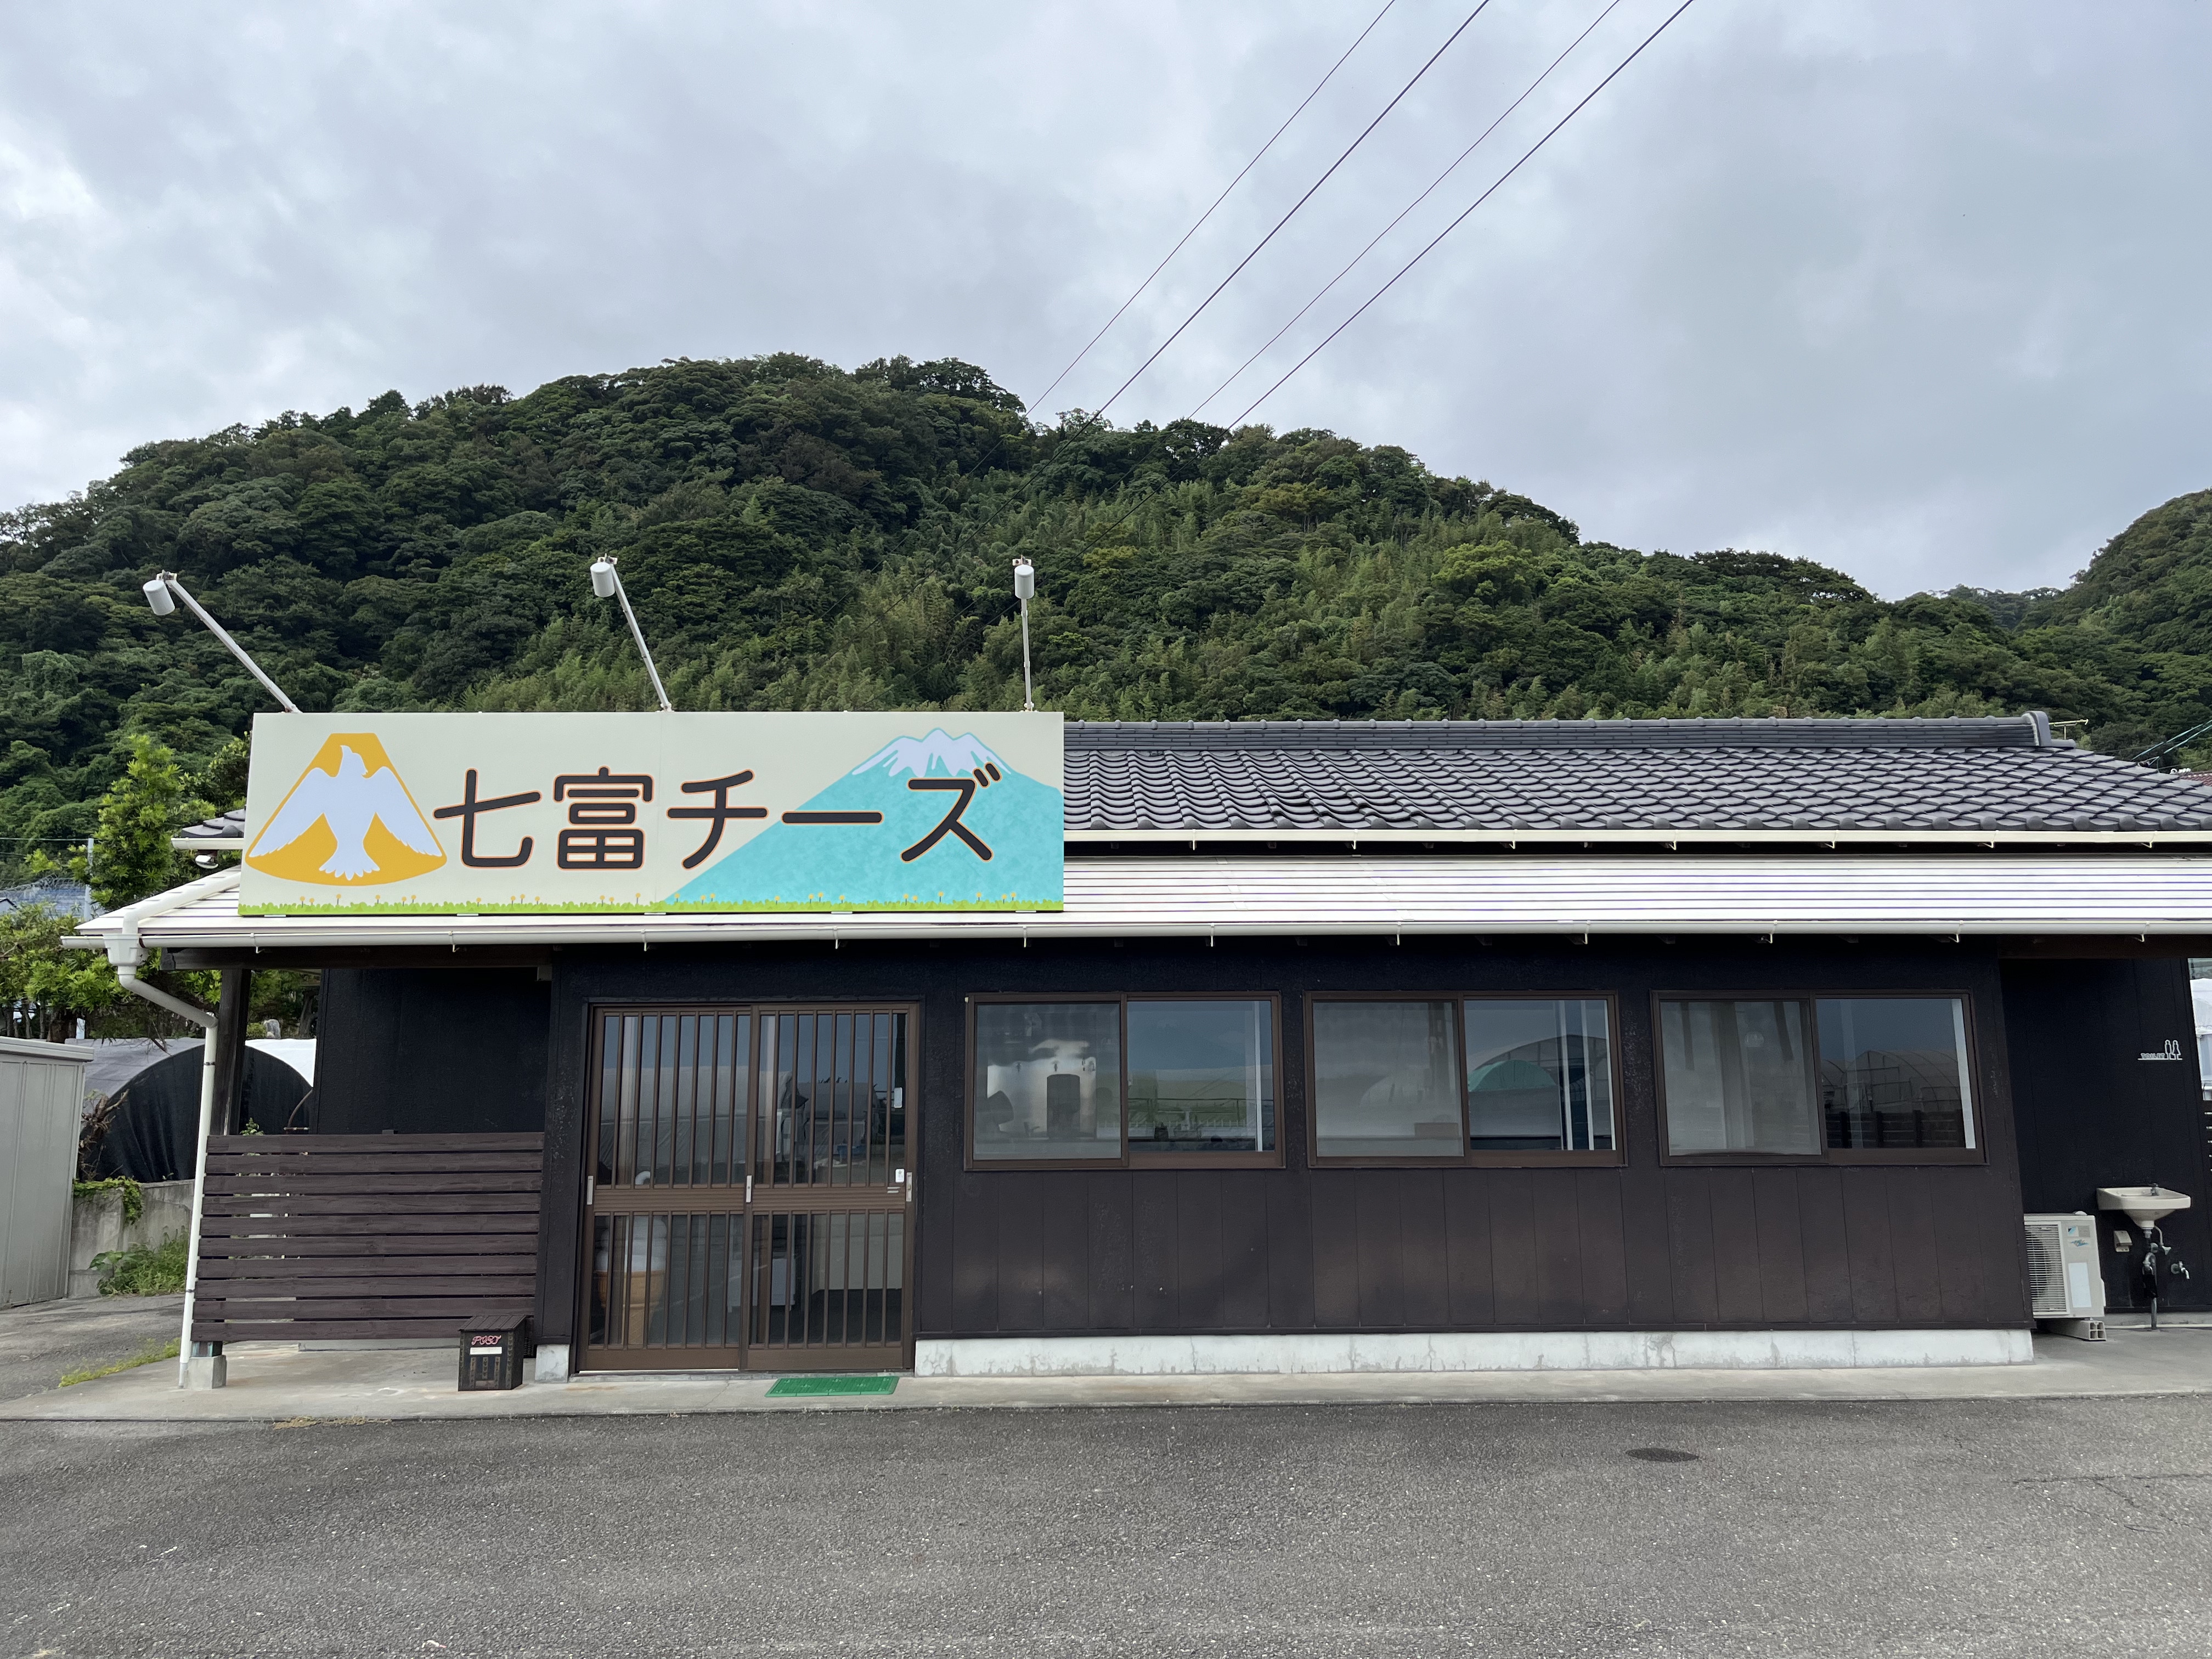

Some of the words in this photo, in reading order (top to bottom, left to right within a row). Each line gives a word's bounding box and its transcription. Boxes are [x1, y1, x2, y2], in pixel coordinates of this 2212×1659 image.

[433, 763, 1001, 871] 七富チーズ
[471, 1335, 501, 1345] POST
